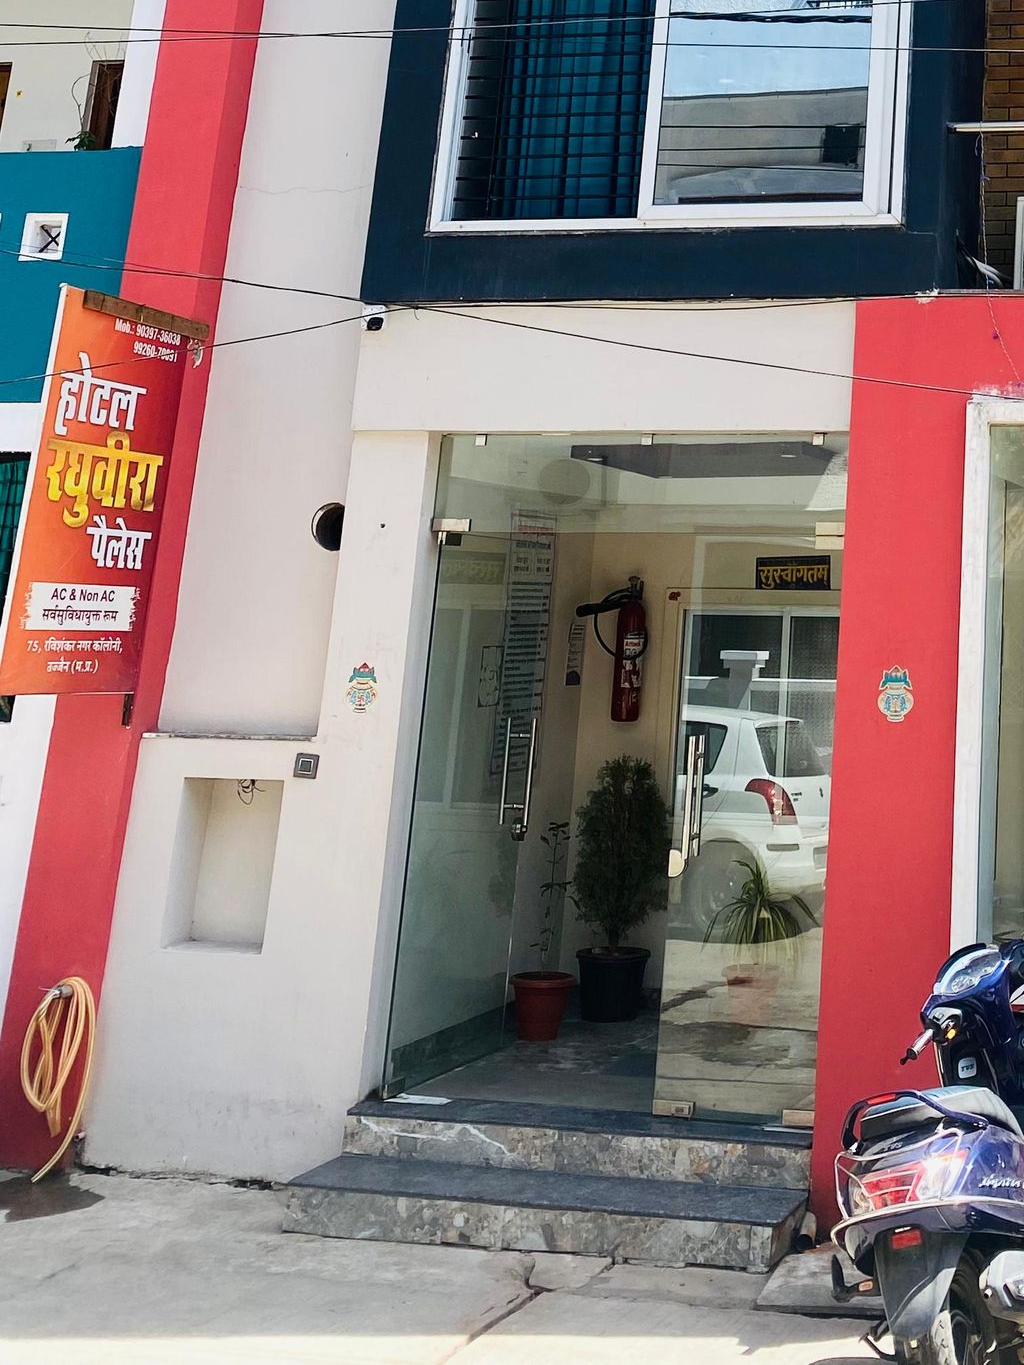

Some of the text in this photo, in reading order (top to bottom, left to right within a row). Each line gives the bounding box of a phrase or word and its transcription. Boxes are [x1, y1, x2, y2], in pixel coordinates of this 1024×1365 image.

[54, 352, 147, 436] होटल
[46, 431, 164, 528] रघुवीरा
[86, 515, 152, 570] पैलेस
[51, 587, 116, 602] AC & Non AC
[103, 610, 119, 622] रूम
[26, 640, 42, 653] 75,
[76, 640, 92, 652] नगर
